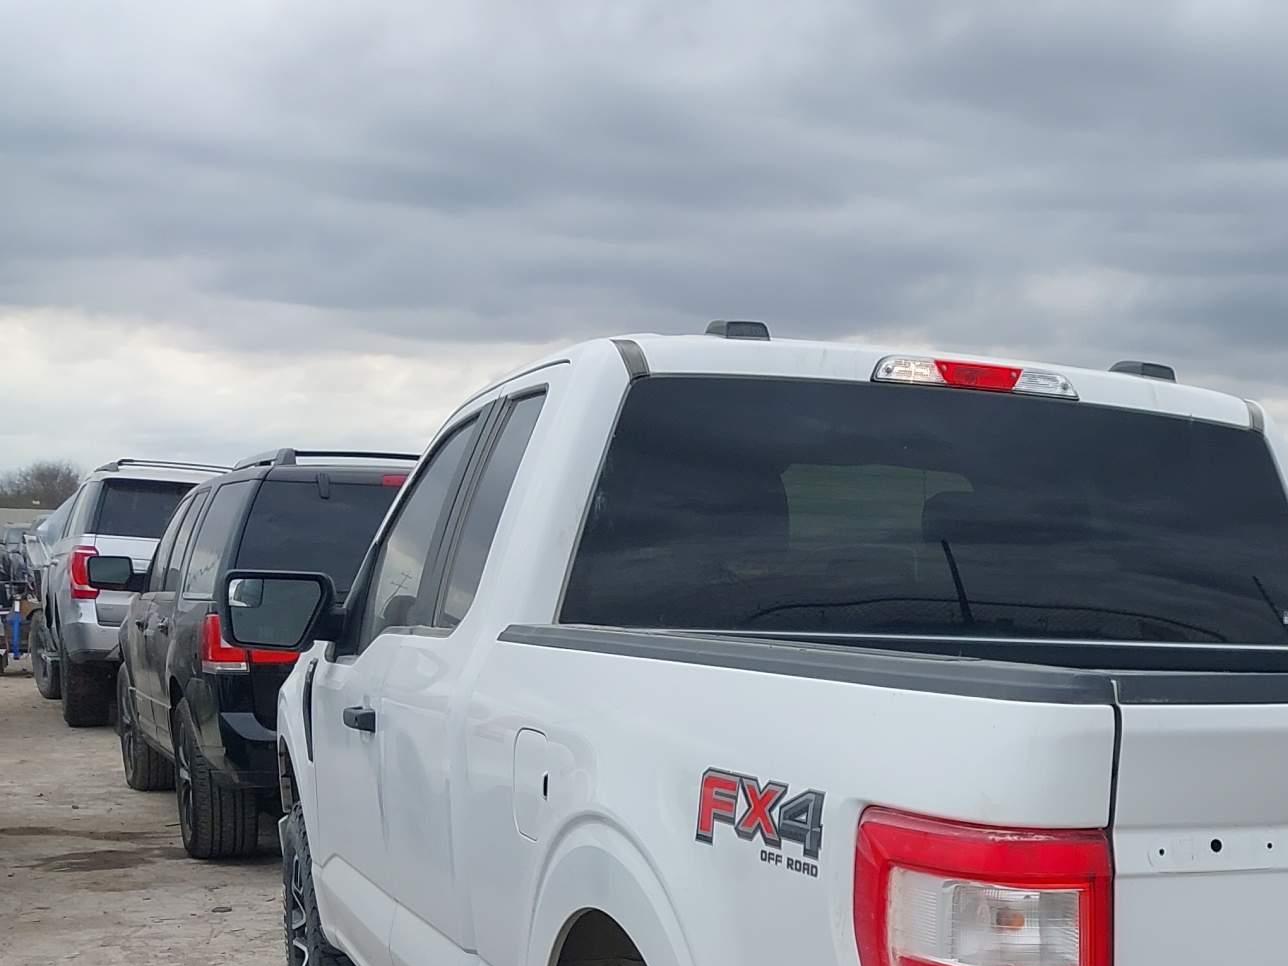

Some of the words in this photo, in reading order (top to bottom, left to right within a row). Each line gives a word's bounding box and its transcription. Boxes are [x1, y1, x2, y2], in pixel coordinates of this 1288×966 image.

[695, 766, 825, 861] FX4
[760, 850, 783, 866] OFF
[786, 857, 819, 878] ROAD
